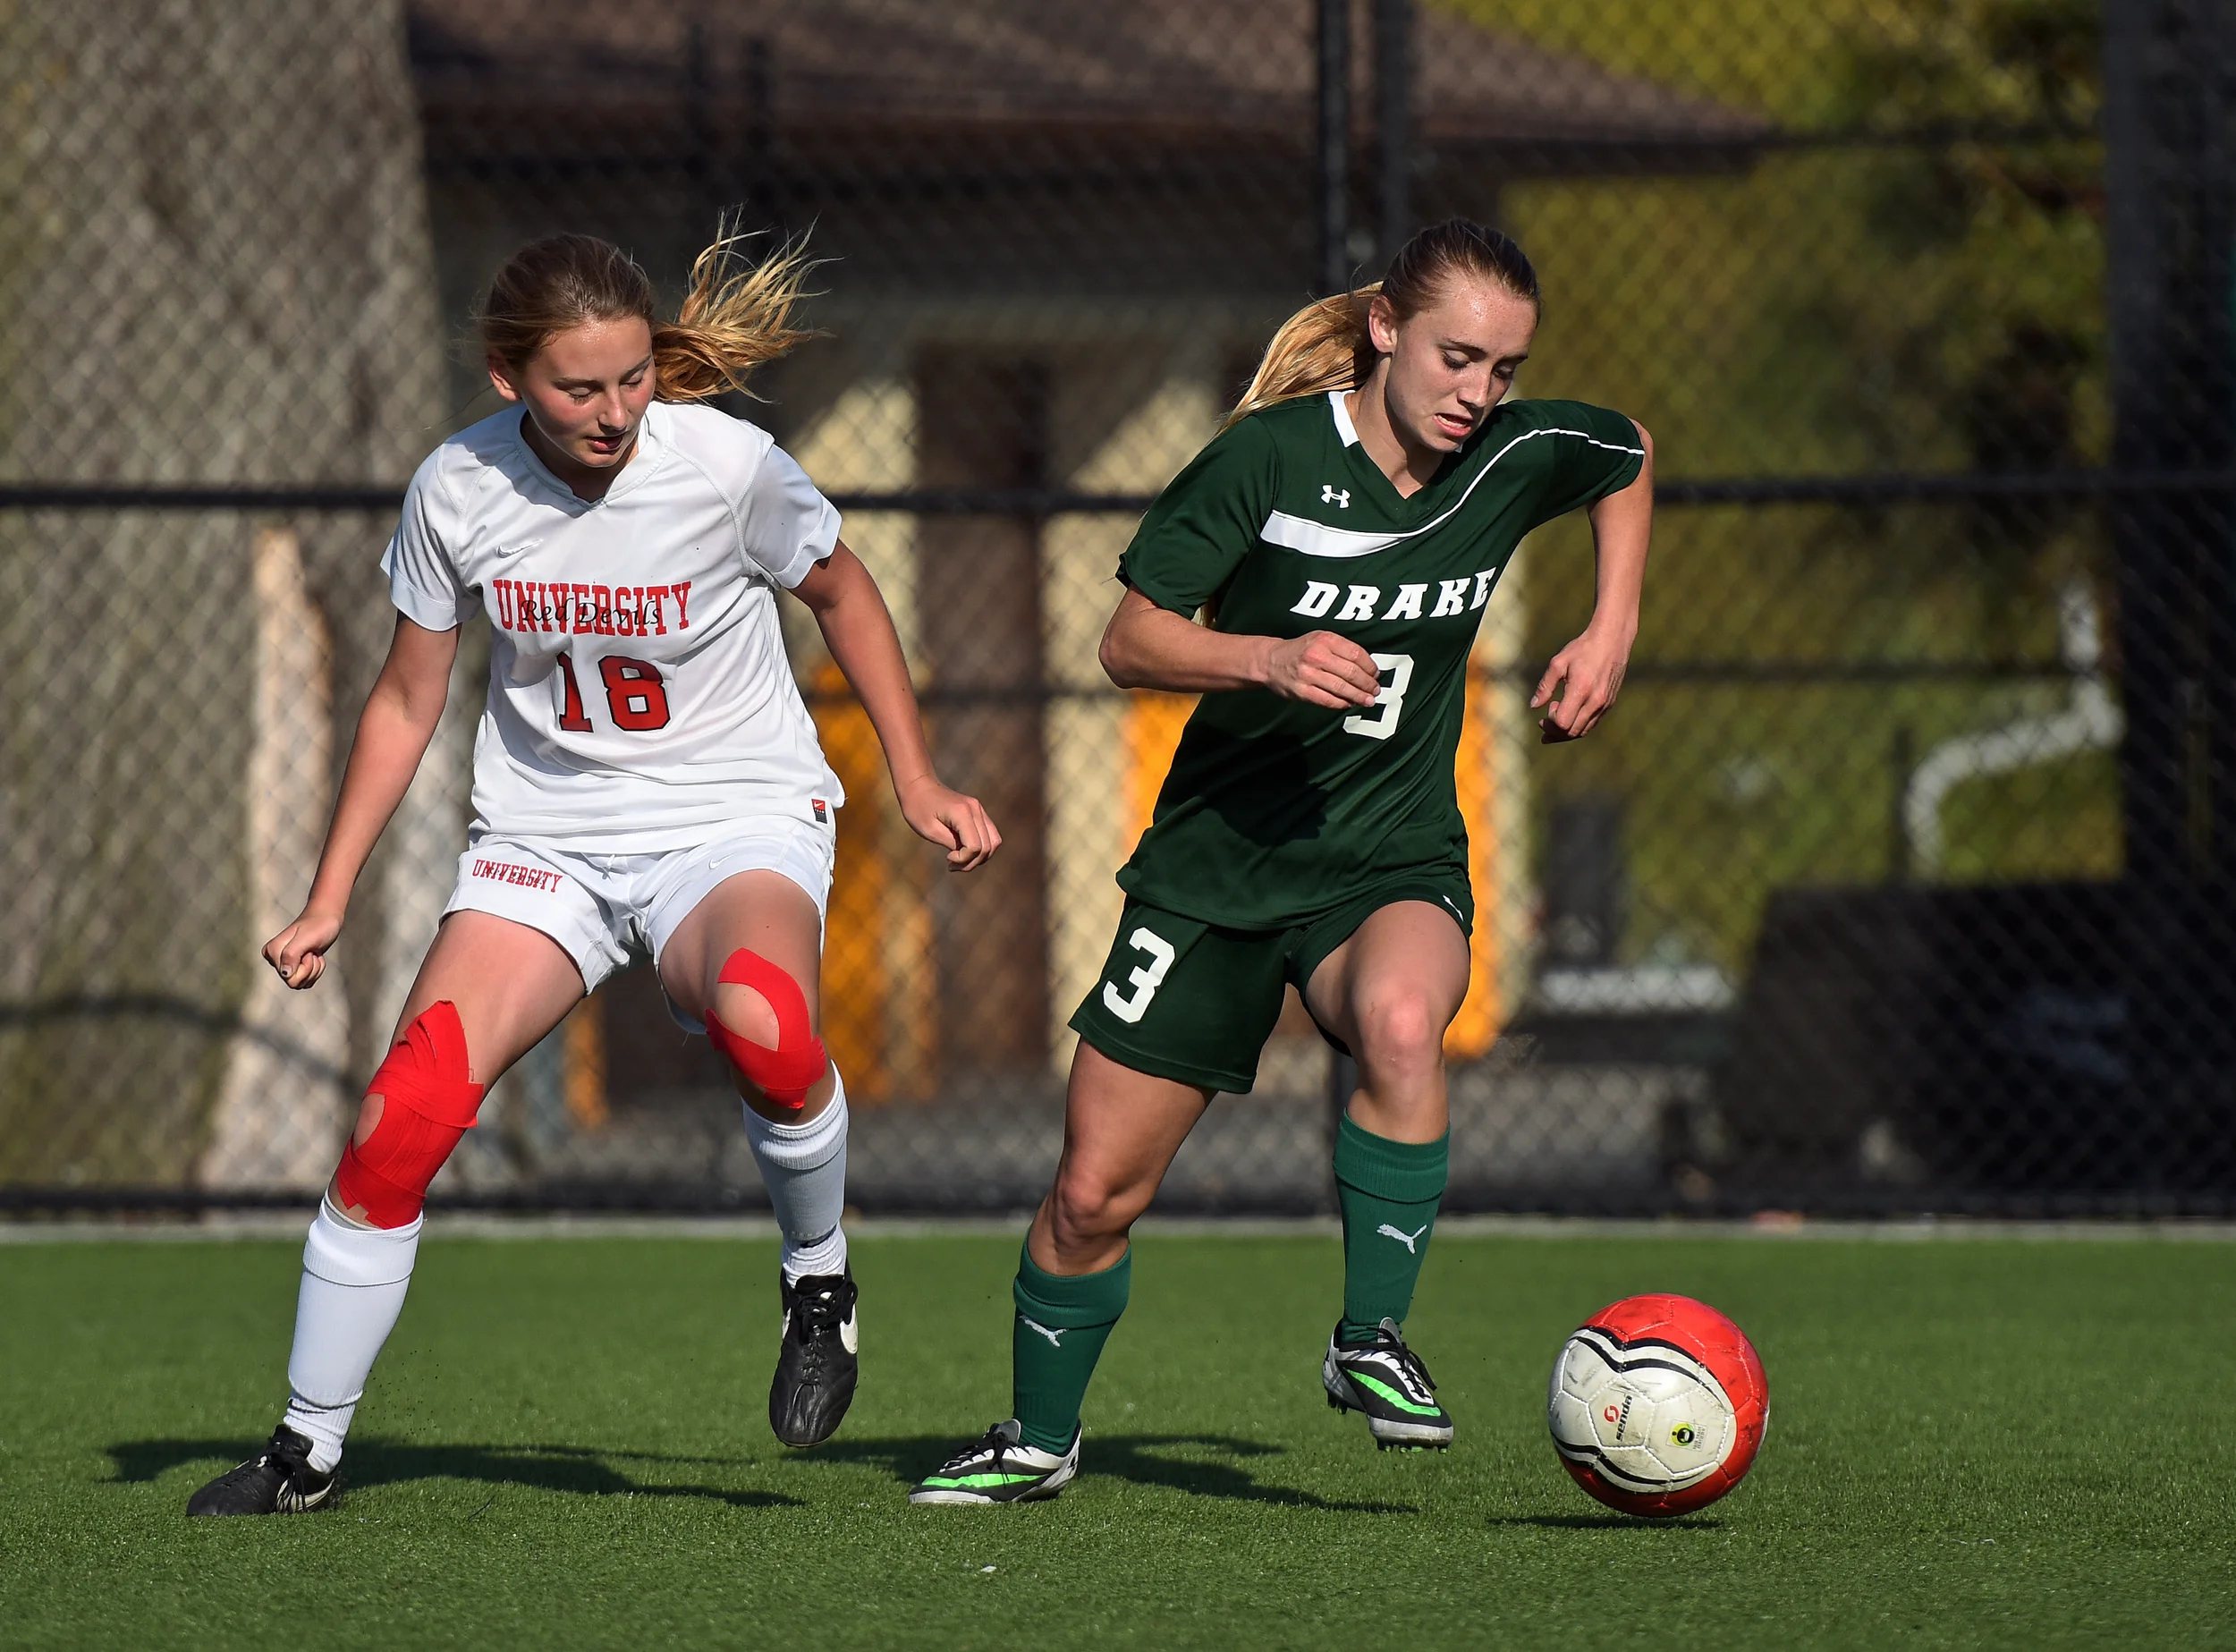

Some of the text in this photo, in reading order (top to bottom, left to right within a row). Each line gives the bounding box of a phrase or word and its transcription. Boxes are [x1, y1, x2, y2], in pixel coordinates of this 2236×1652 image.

[493, 580, 691, 636] UNIVERSITY
[521, 597, 661, 625] Red Devils
[1289, 567, 1496, 621] DRAKE
[556, 651, 672, 733] 18
[1342, 653, 1414, 741] 3
[472, 859, 563, 893] UNIVERSITY
[1103, 927, 1175, 1023] 3
[1616, 1395, 1632, 1442] senda
